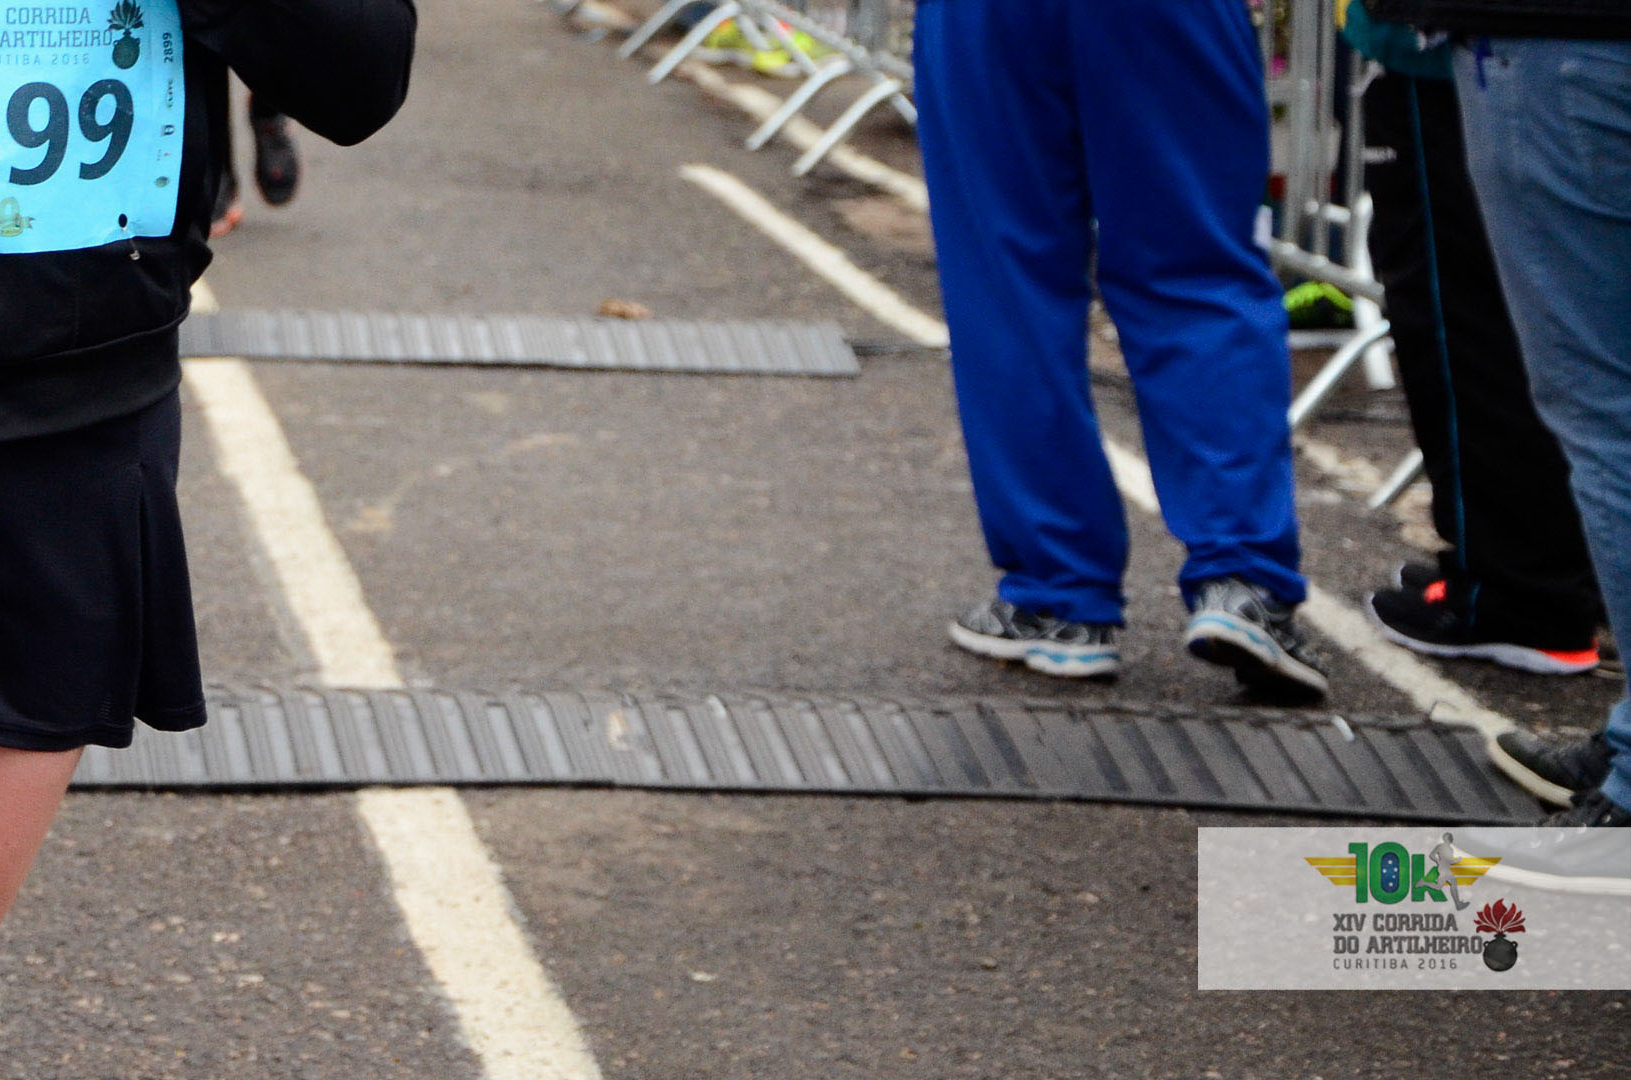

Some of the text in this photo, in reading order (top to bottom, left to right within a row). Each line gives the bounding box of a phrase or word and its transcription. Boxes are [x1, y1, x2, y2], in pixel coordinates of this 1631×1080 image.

[5, 7, 92, 25] CORRIDA
[0, 28, 113, 48] ARTILHEIRO
[163, 32, 173, 63] 2899
[51, 53, 91, 65] 2016
